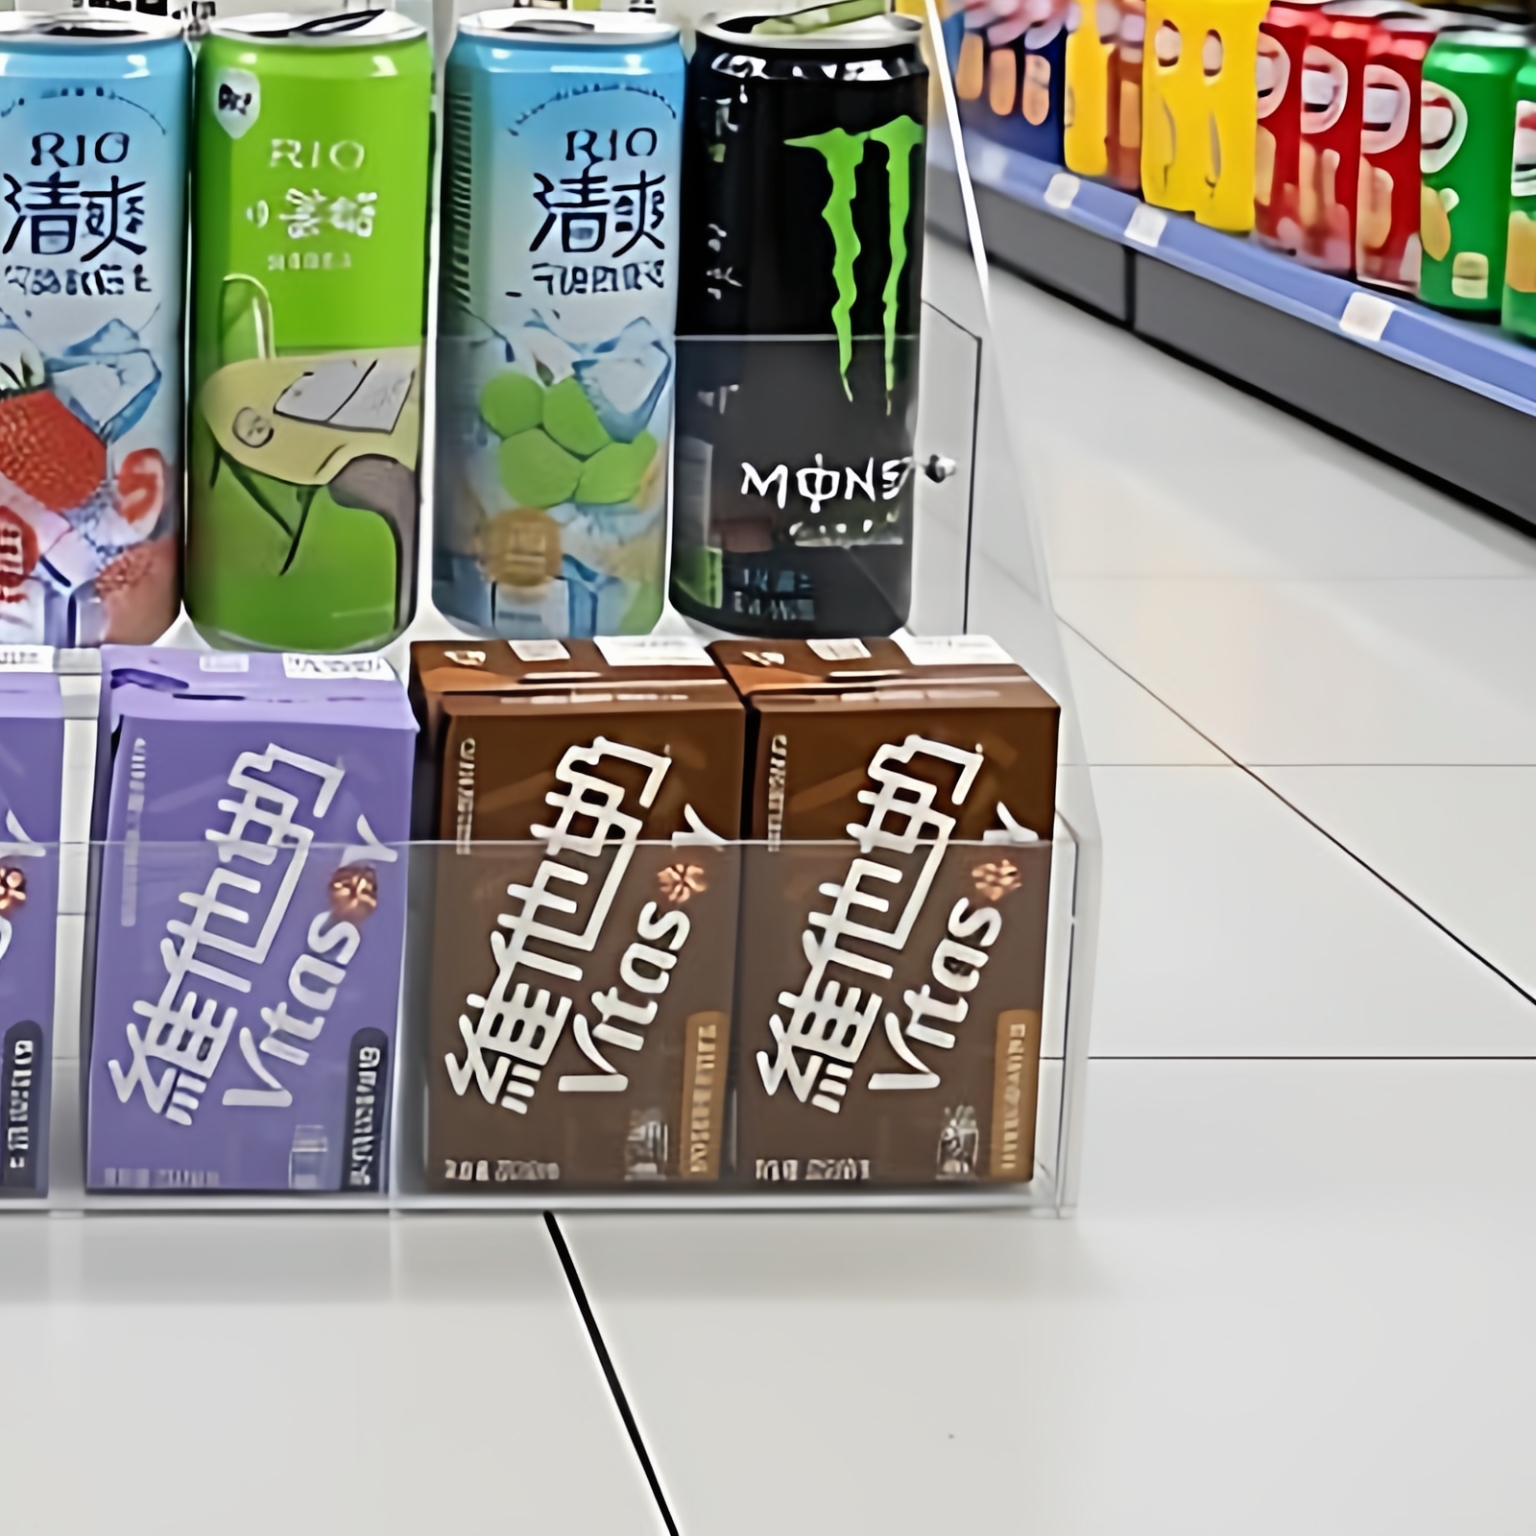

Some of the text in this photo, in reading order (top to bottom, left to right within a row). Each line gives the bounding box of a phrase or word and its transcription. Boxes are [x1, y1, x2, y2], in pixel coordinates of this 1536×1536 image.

[30, 131, 130, 167] RIO
[270, 138, 365, 171] RIO
[565, 126, 658, 162] RIO
